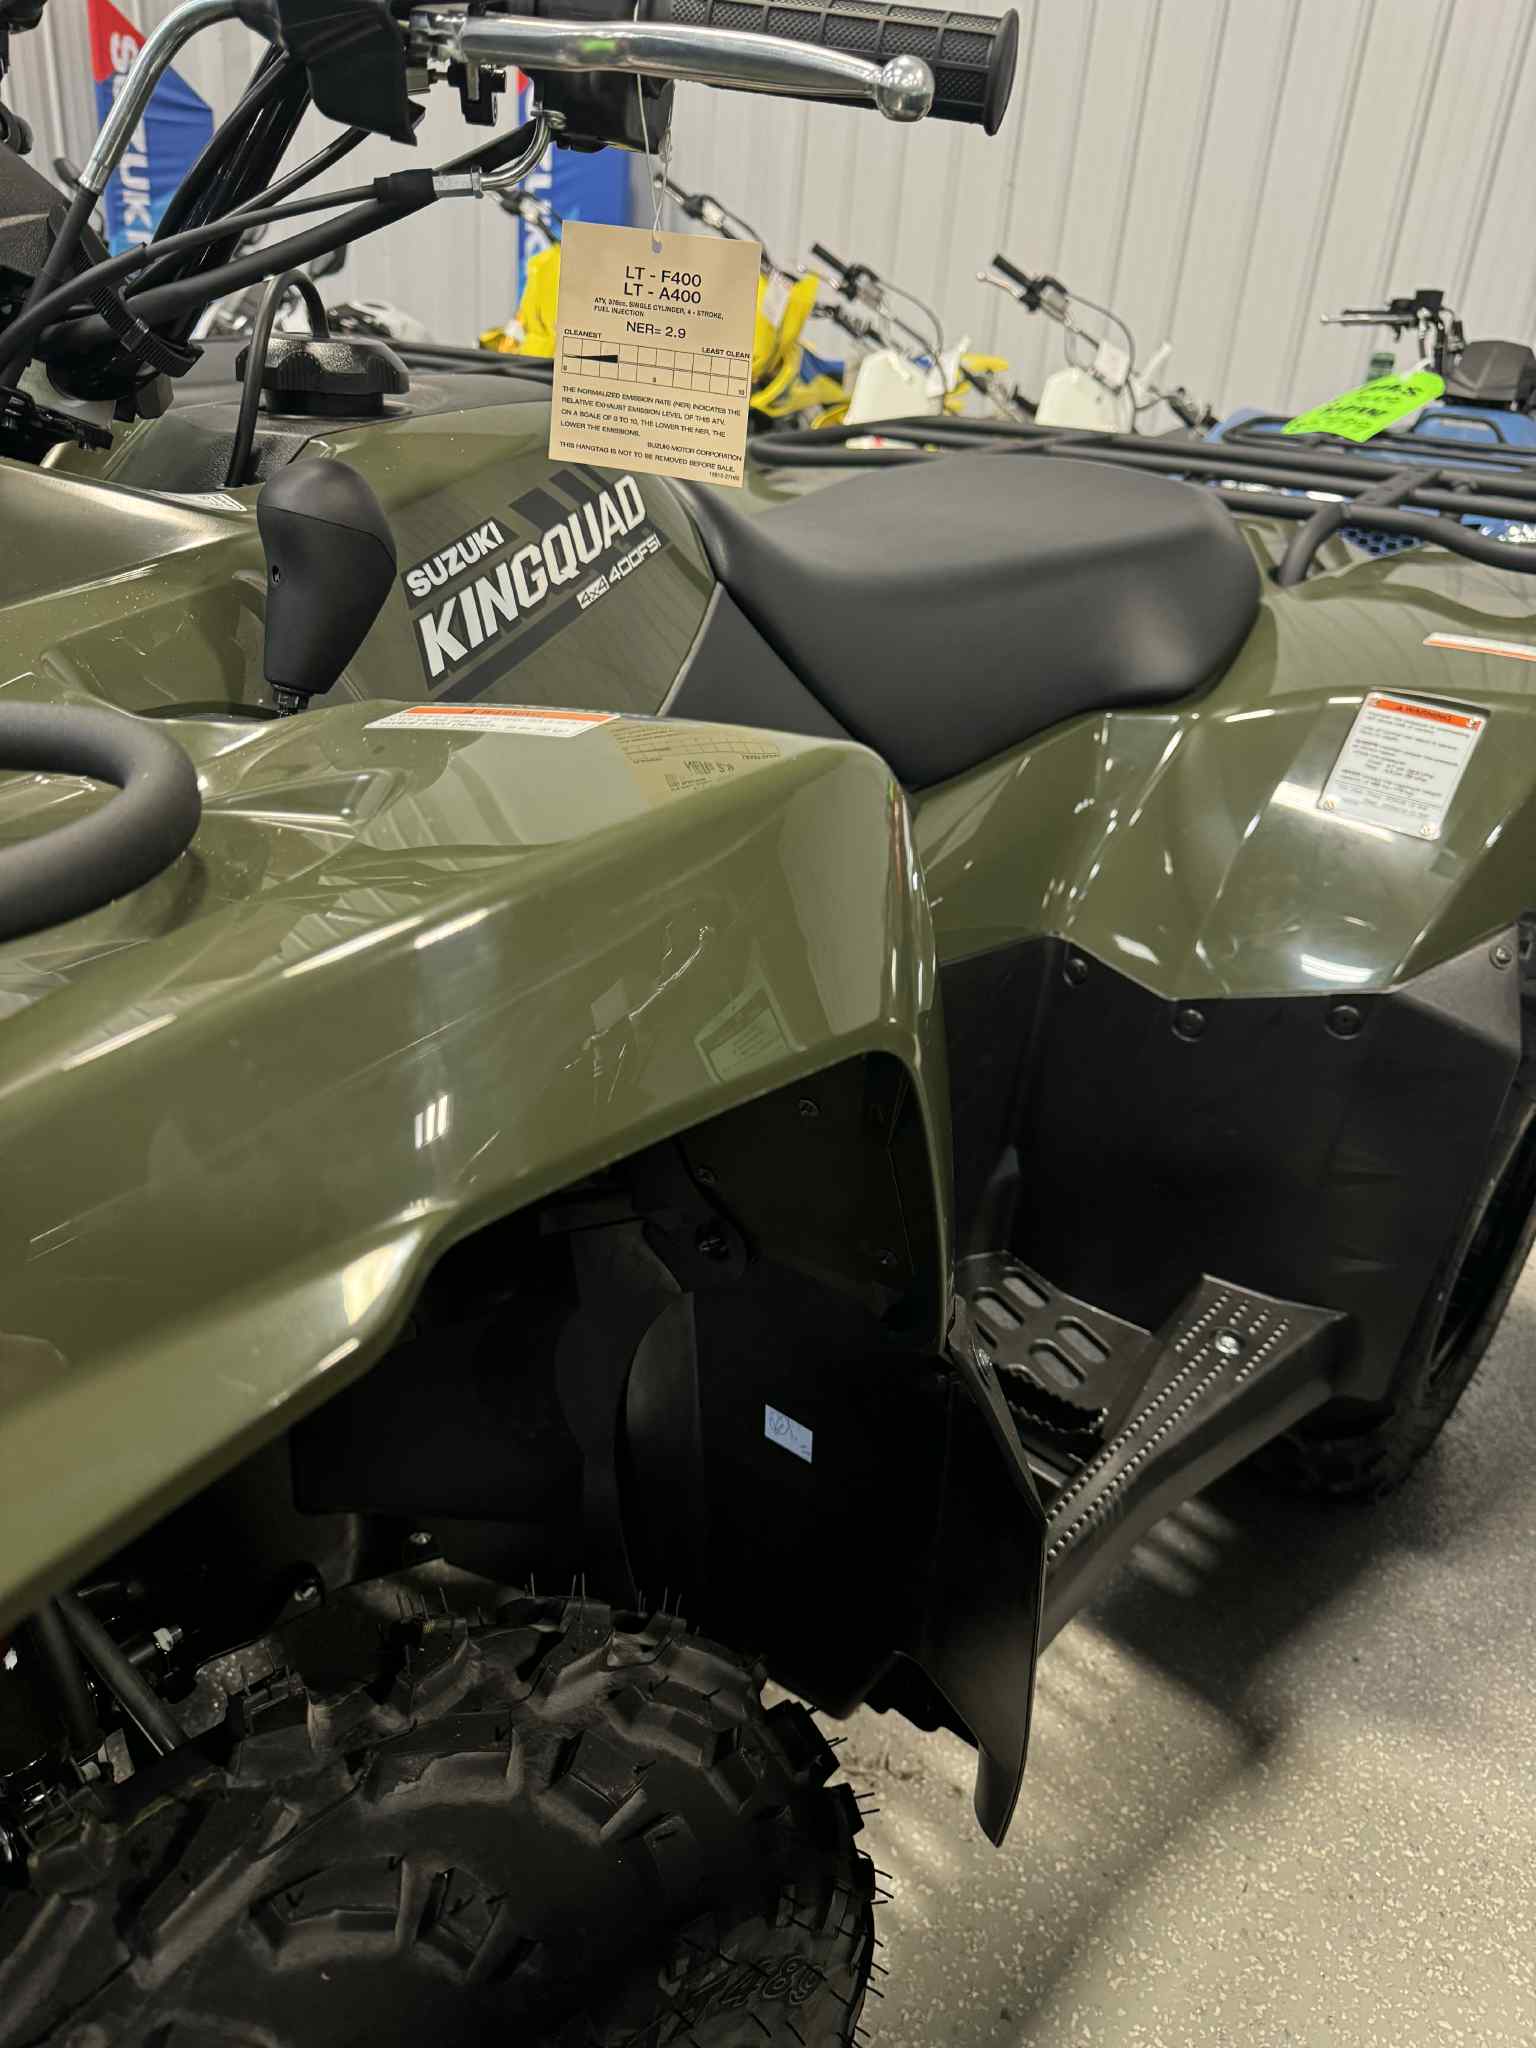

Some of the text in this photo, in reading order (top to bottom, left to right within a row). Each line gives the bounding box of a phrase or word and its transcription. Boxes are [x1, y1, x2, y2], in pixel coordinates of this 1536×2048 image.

[626, 266, 646, 280] LT
[660, 270, 702, 288] F400
[624, 282, 644, 296] LT
[659, 287, 702, 304] A400
[611, 307, 644, 317] INJECTION
[629, 302, 652, 310] SINGLE
[564, 329, 602, 338] CLEANEST
[626, 321, 686, 339] NER= 2.9
[702, 346, 750, 360] LEAST CLEAN
[562, 396, 594, 407] RELATIVE
[595, 402, 626, 412] EXHAUST
[628, 406, 660, 416] EMISSION
[662, 410, 682, 420] LEVEL
[576, 387, 621, 399] NORMALIZED
[622, 394, 654, 404] EMISSION
[655, 398, 672, 406] RATE
[692, 404, 727, 414] INDICATES
[728, 408, 740, 416] THE
[560, 420, 586, 430] LOWER
[586, 423, 601, 432] THE
[580, 411, 601, 420] SCALE
[640, 419, 654, 428] THE
[655, 422, 680, 431] LOWER
[681, 426, 694, 434] THE
[576, 443, 609, 454] HANGTAG
[618, 449, 632, 457] NOT
[654, 454, 688, 465] REMOVED
[689, 460, 716, 470] BEFORE
[648, 441, 742, 462] SUZUKI MOTOR CORPORATION
[405, 520, 505, 598] SUZUKI
[418, 474, 647, 678] KINGQUAD
